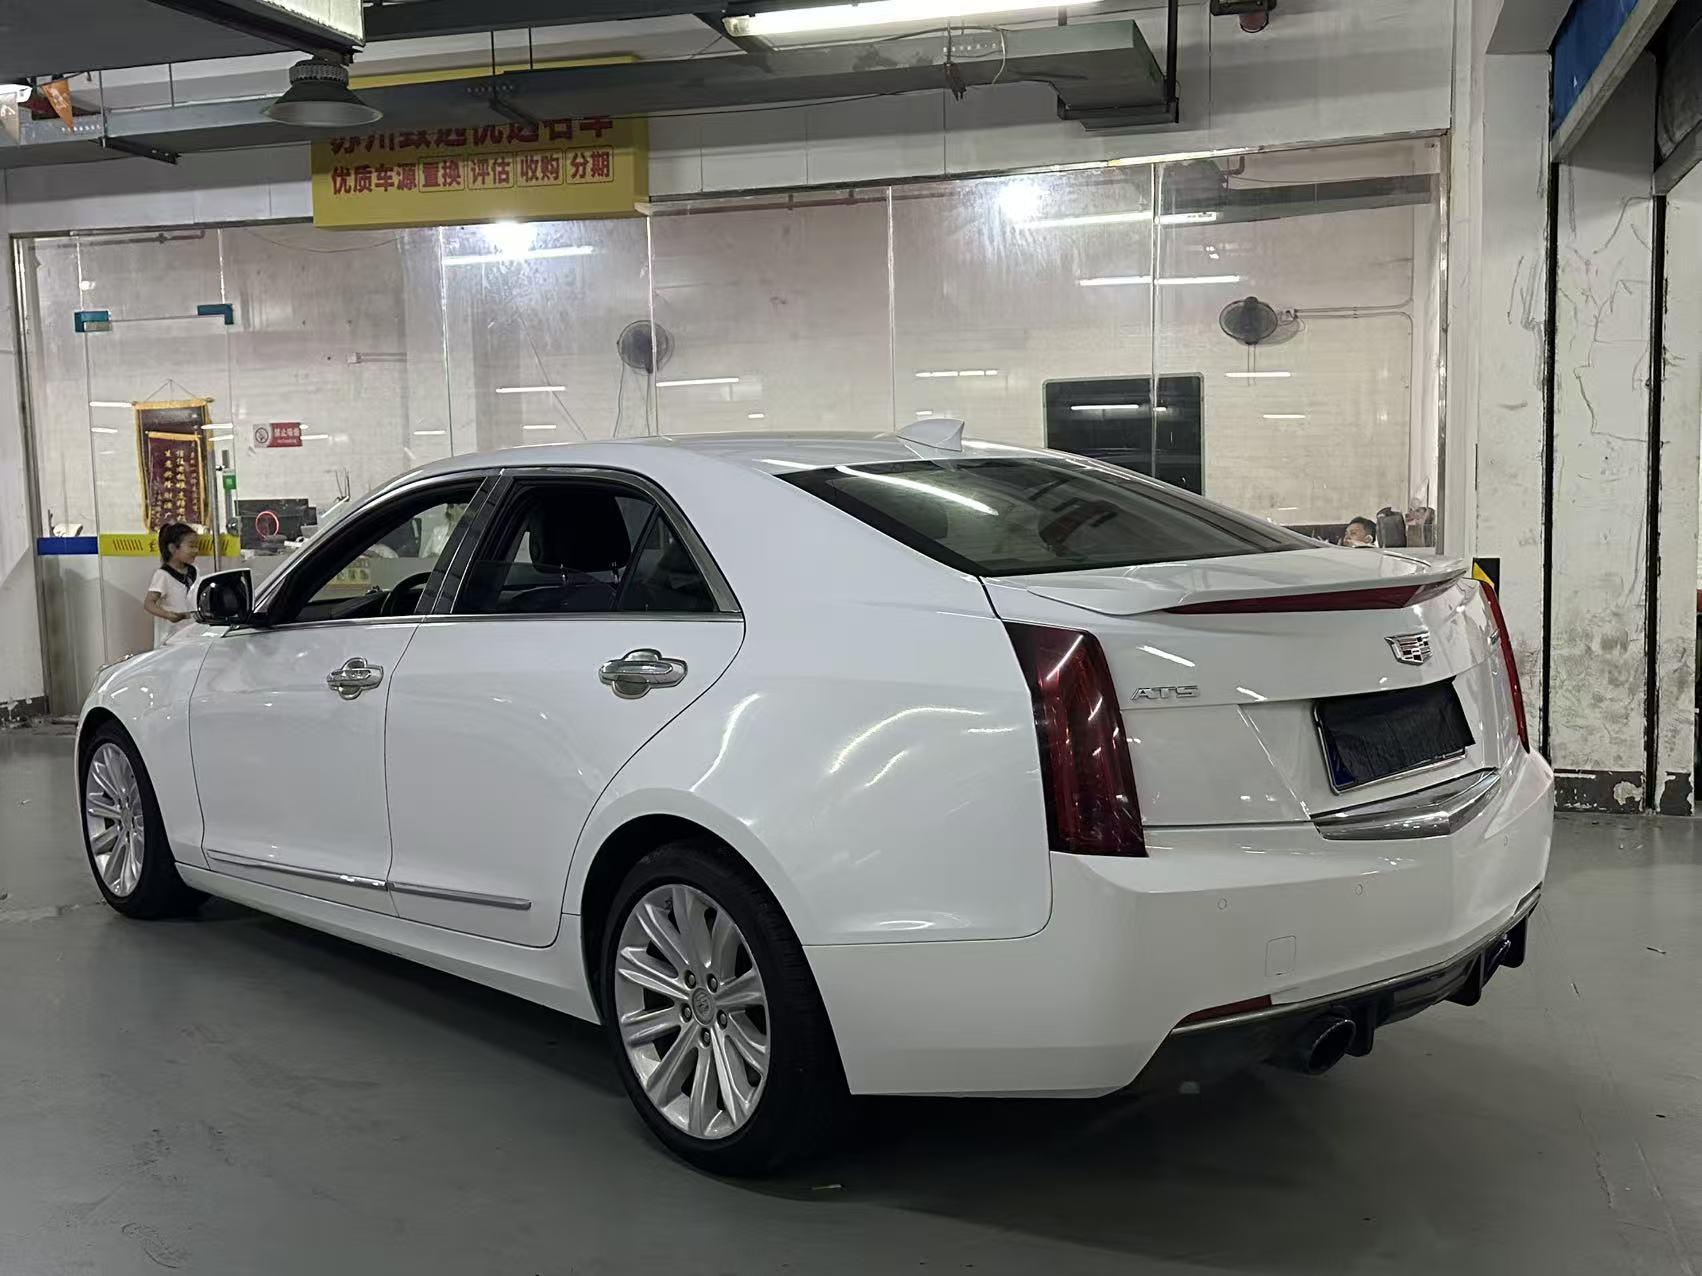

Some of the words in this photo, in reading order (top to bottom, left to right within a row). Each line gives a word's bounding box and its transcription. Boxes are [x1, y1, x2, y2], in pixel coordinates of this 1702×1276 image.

[331, 162, 417, 195] 优质车源
[422, 159, 461, 187] 置换
[470, 155, 511, 185] 评估
[520, 152, 560, 182] 收购
[569, 151, 611, 179] 分期
[1130, 685, 1200, 701] ATS
